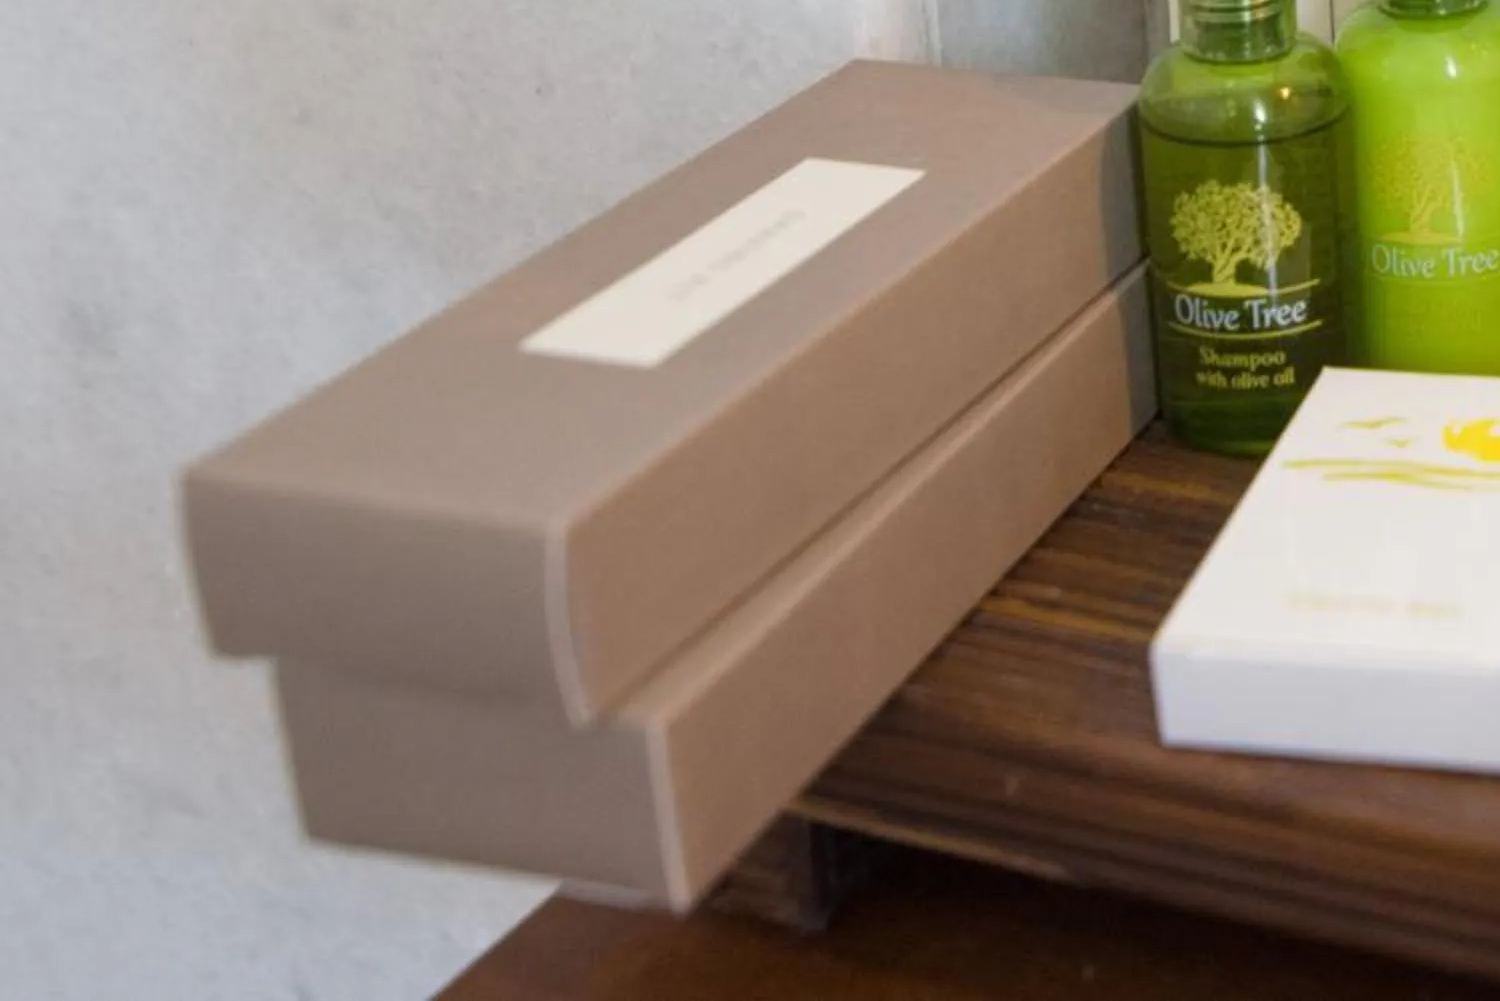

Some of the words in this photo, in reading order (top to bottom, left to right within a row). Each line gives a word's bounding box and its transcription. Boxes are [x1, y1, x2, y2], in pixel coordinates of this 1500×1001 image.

[1372, 243, 1436, 279] Olive
[1441, 246, 1500, 277] Tree
[1174, 294, 1241, 331] Olive
[1244, 298, 1308, 330] Tree
[1199, 346, 1287, 372] Shampoo
